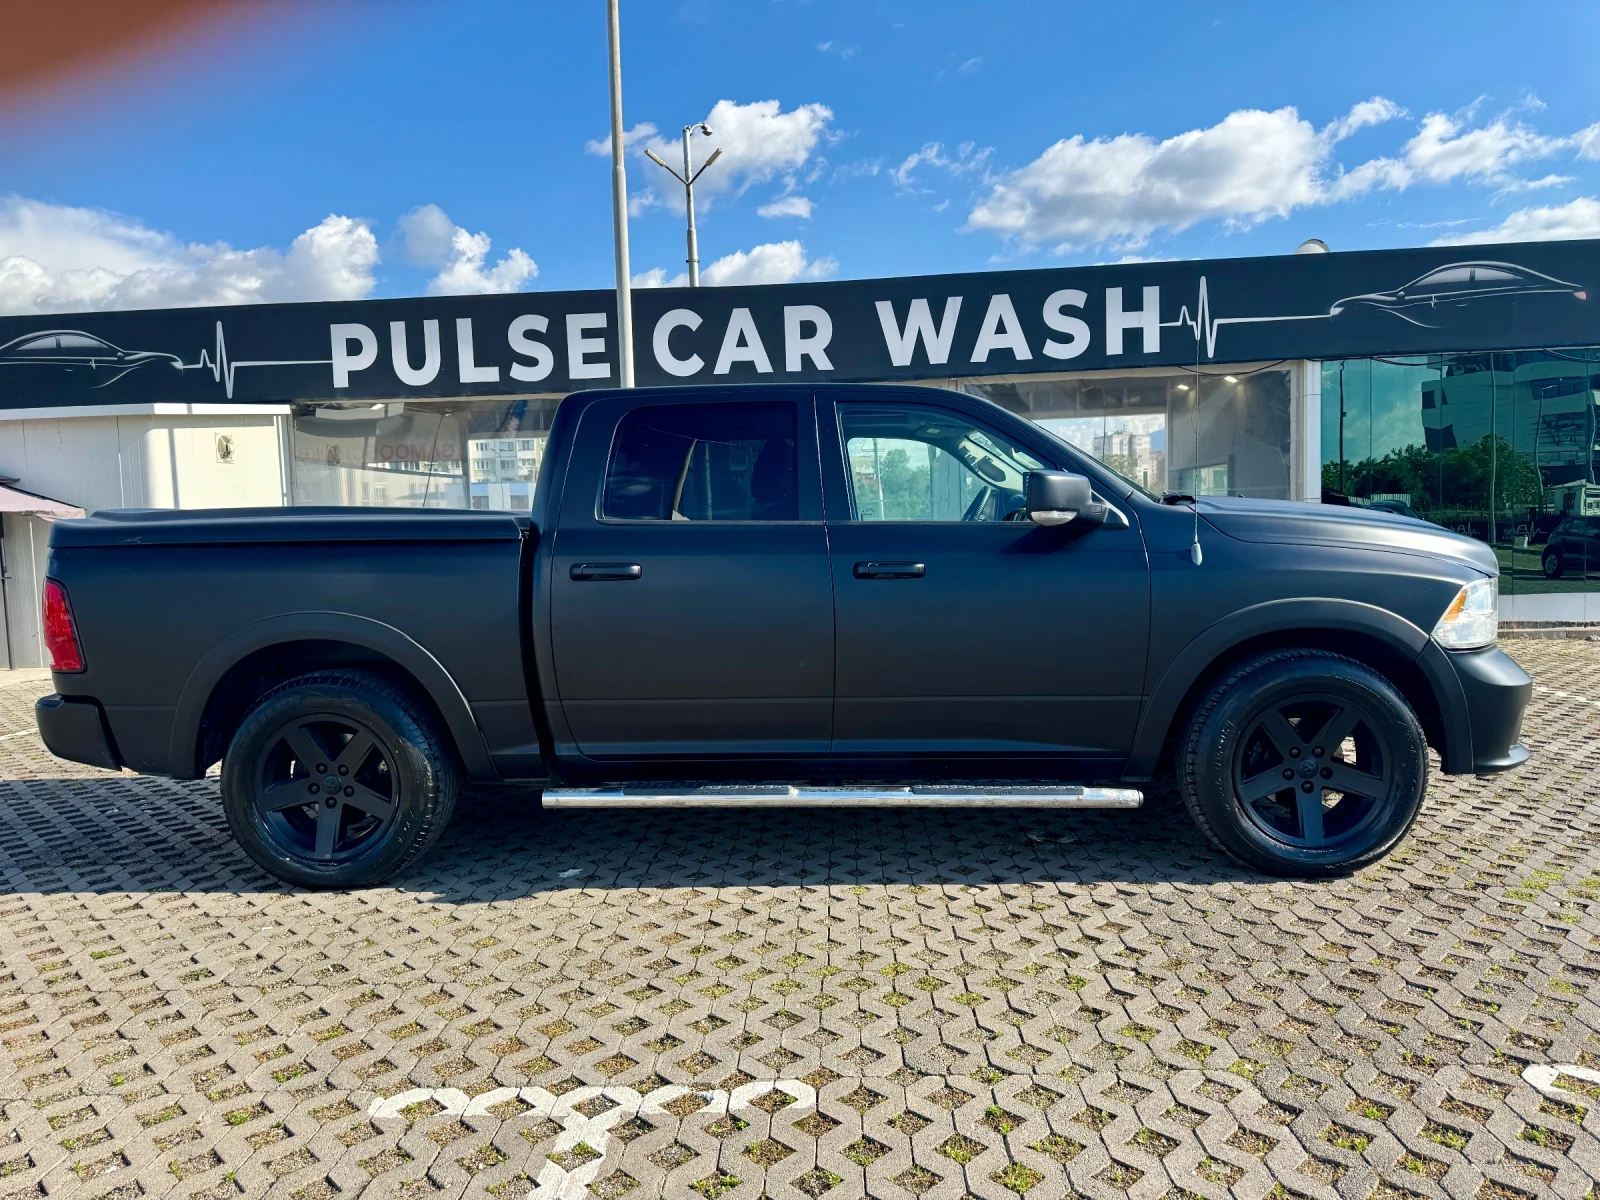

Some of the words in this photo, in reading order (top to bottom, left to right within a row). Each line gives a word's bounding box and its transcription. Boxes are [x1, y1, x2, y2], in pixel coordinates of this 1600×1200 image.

[329, 312, 612, 389] PULSE
[652, 305, 835, 377] CAR
[875, 285, 1161, 367] WASH
